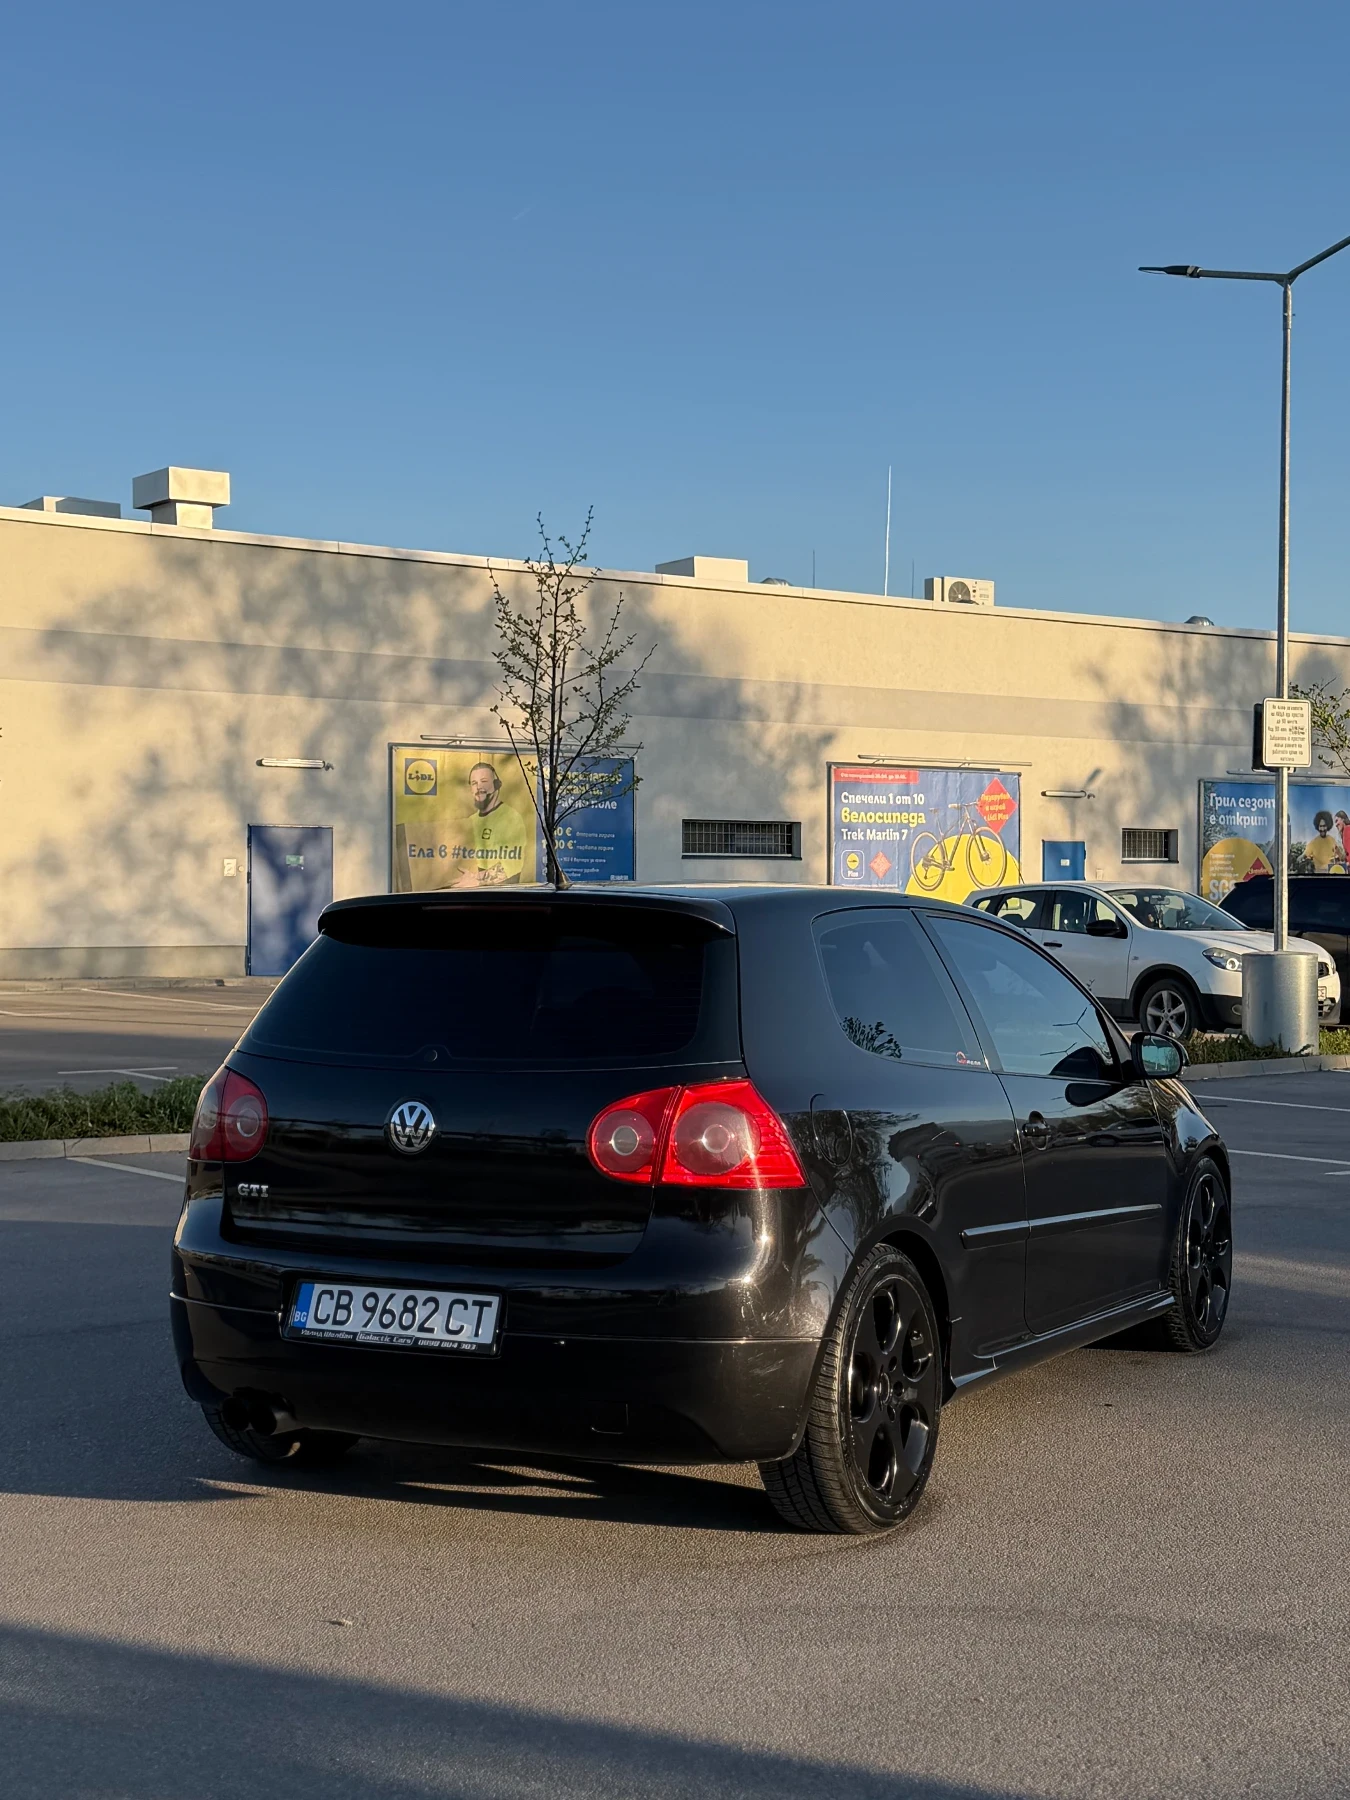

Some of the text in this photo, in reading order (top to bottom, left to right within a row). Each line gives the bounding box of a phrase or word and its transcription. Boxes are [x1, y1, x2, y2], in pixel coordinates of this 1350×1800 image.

[841, 791, 925, 805] Спечели 1 от 10
[1209, 793, 1236, 810] Грил
[841, 807, 926, 828] велосипеда
[1209, 812, 1268, 828] е открит
[841, 828, 908, 841] Trek Marlin 7
[408, 844, 434, 858] Ела
[451, 845, 523, 860] #teamlidl
[238, 1183, 269, 1197] GTI
[294, 1311, 307, 1323] BG
